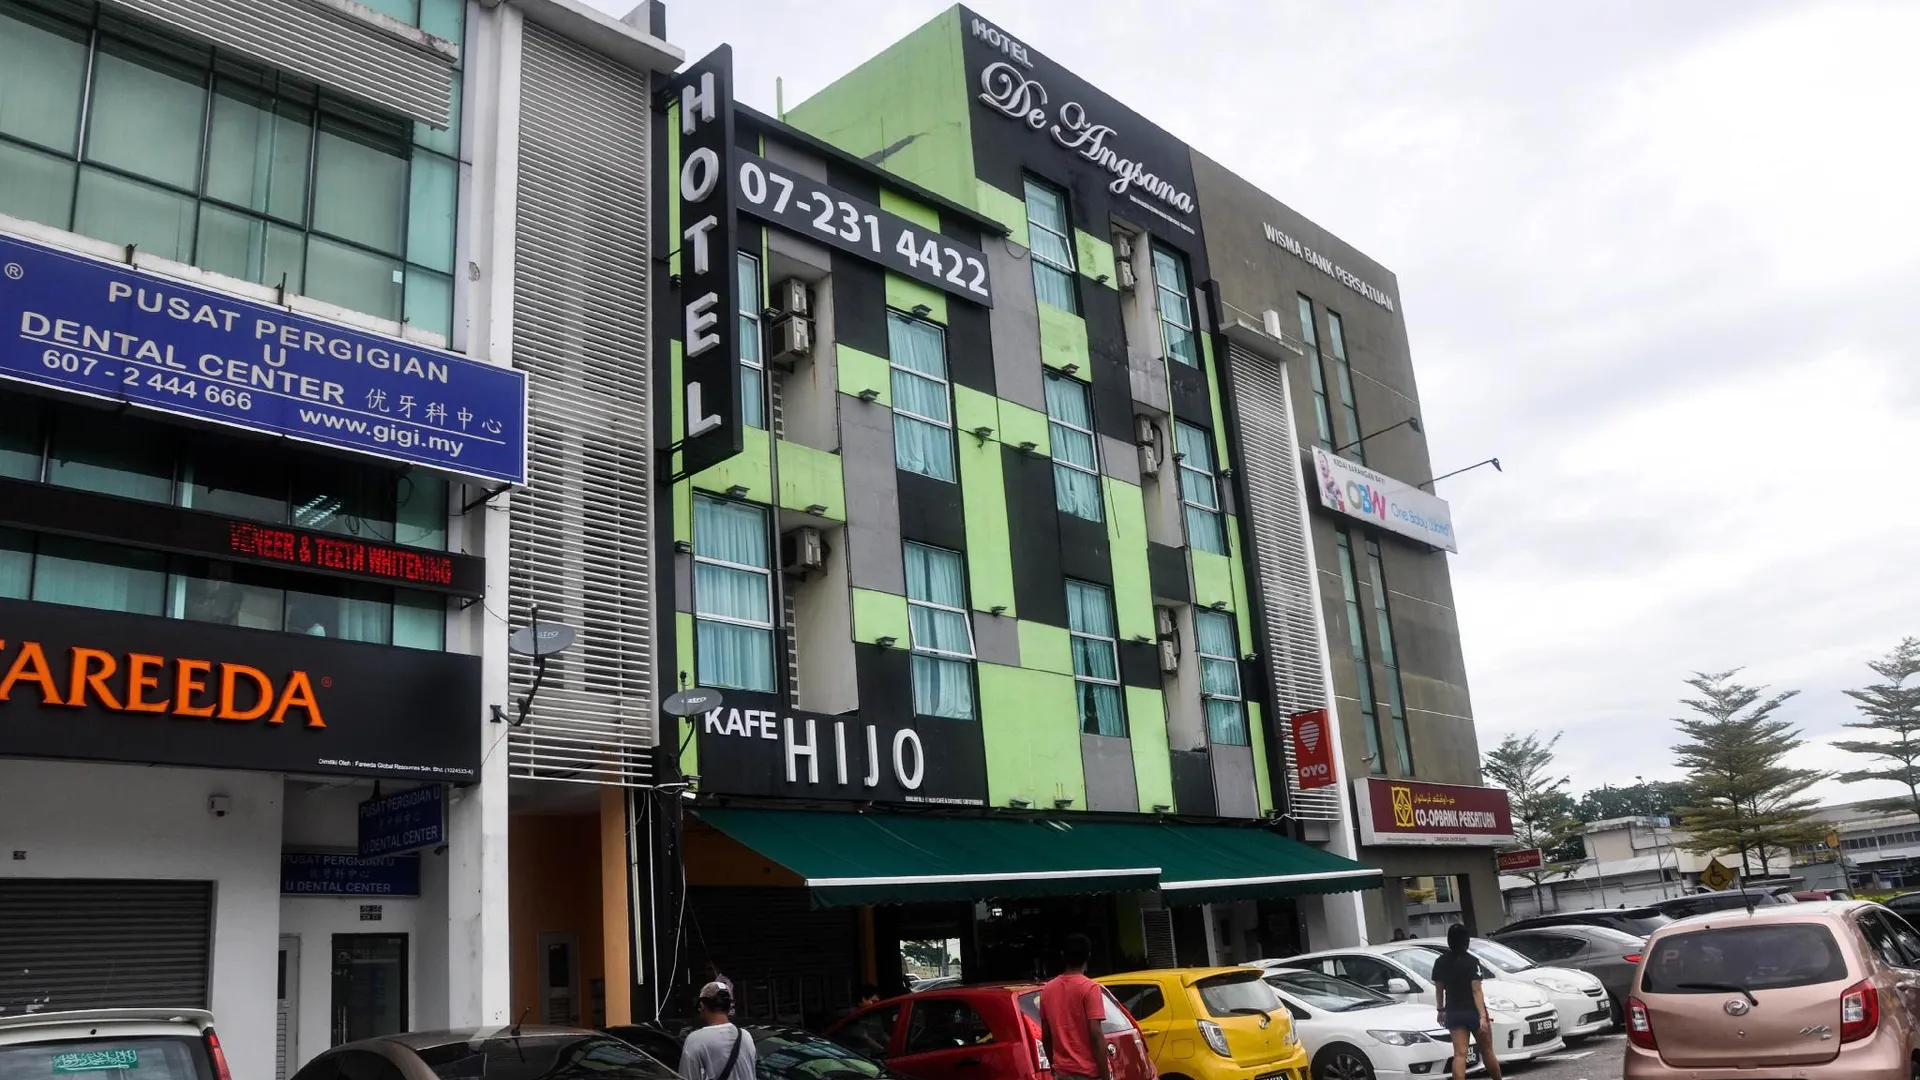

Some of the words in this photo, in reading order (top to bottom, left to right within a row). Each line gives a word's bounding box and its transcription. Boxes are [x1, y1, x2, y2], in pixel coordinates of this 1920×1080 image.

[971, 18, 1034, 69] HOTEL
[978, 61, 1048, 129] De
[1050, 101, 1195, 214] Angsana
[739, 161, 881, 253] 07-231
[895, 228, 989, 297] 4422
[680, 70, 722, 438] HOTEL
[1263, 221, 1303, 259] WISMA
[1304, 246, 1335, 278] BANK
[1335, 265, 1394, 313] PERSATUAN
[109, 281, 241, 333] PUSAT
[256, 320, 448, 384] PERGIGIAN
[264, 344, 287, 367] U
[21, 311, 186, 367] DENTAL
[199, 354, 345, 405] CENTER
[43, 349, 98, 377] 607
[205, 385, 252, 411] 666
[300, 409, 464, 457] www.gigi.my
[365, 388, 502, 435] 优牙科中心
[1346, 480, 1387, 521] OBW
[1391, 502, 1409, 521] One
[300, 536, 311, 563] &
[315, 538, 364, 571] TEETH
[368, 546, 452, 584] WHITENING
[0, 639, 327, 728] AREEDA
[355, 761, 376, 769] Fareeda
[705, 706, 778, 740] KAFE
[784, 717, 925, 790] HIJO
[1301, 764, 1327, 777] OYO
[360, 801, 387, 819] PUSAT
[387, 789, 431, 811] PERGIGIAN
[433, 786, 440, 800] U
[1415, 808, 1459, 827] CO-OPBANK
[1459, 810, 1496, 828] PERSATUAN
[369, 835, 402, 853] DENTAL
[403, 825, 438, 845] CENTER
[285, 882, 294, 891] U
[297, 881, 343, 892] DENTAL
[346, 882, 391, 893] CENTER
